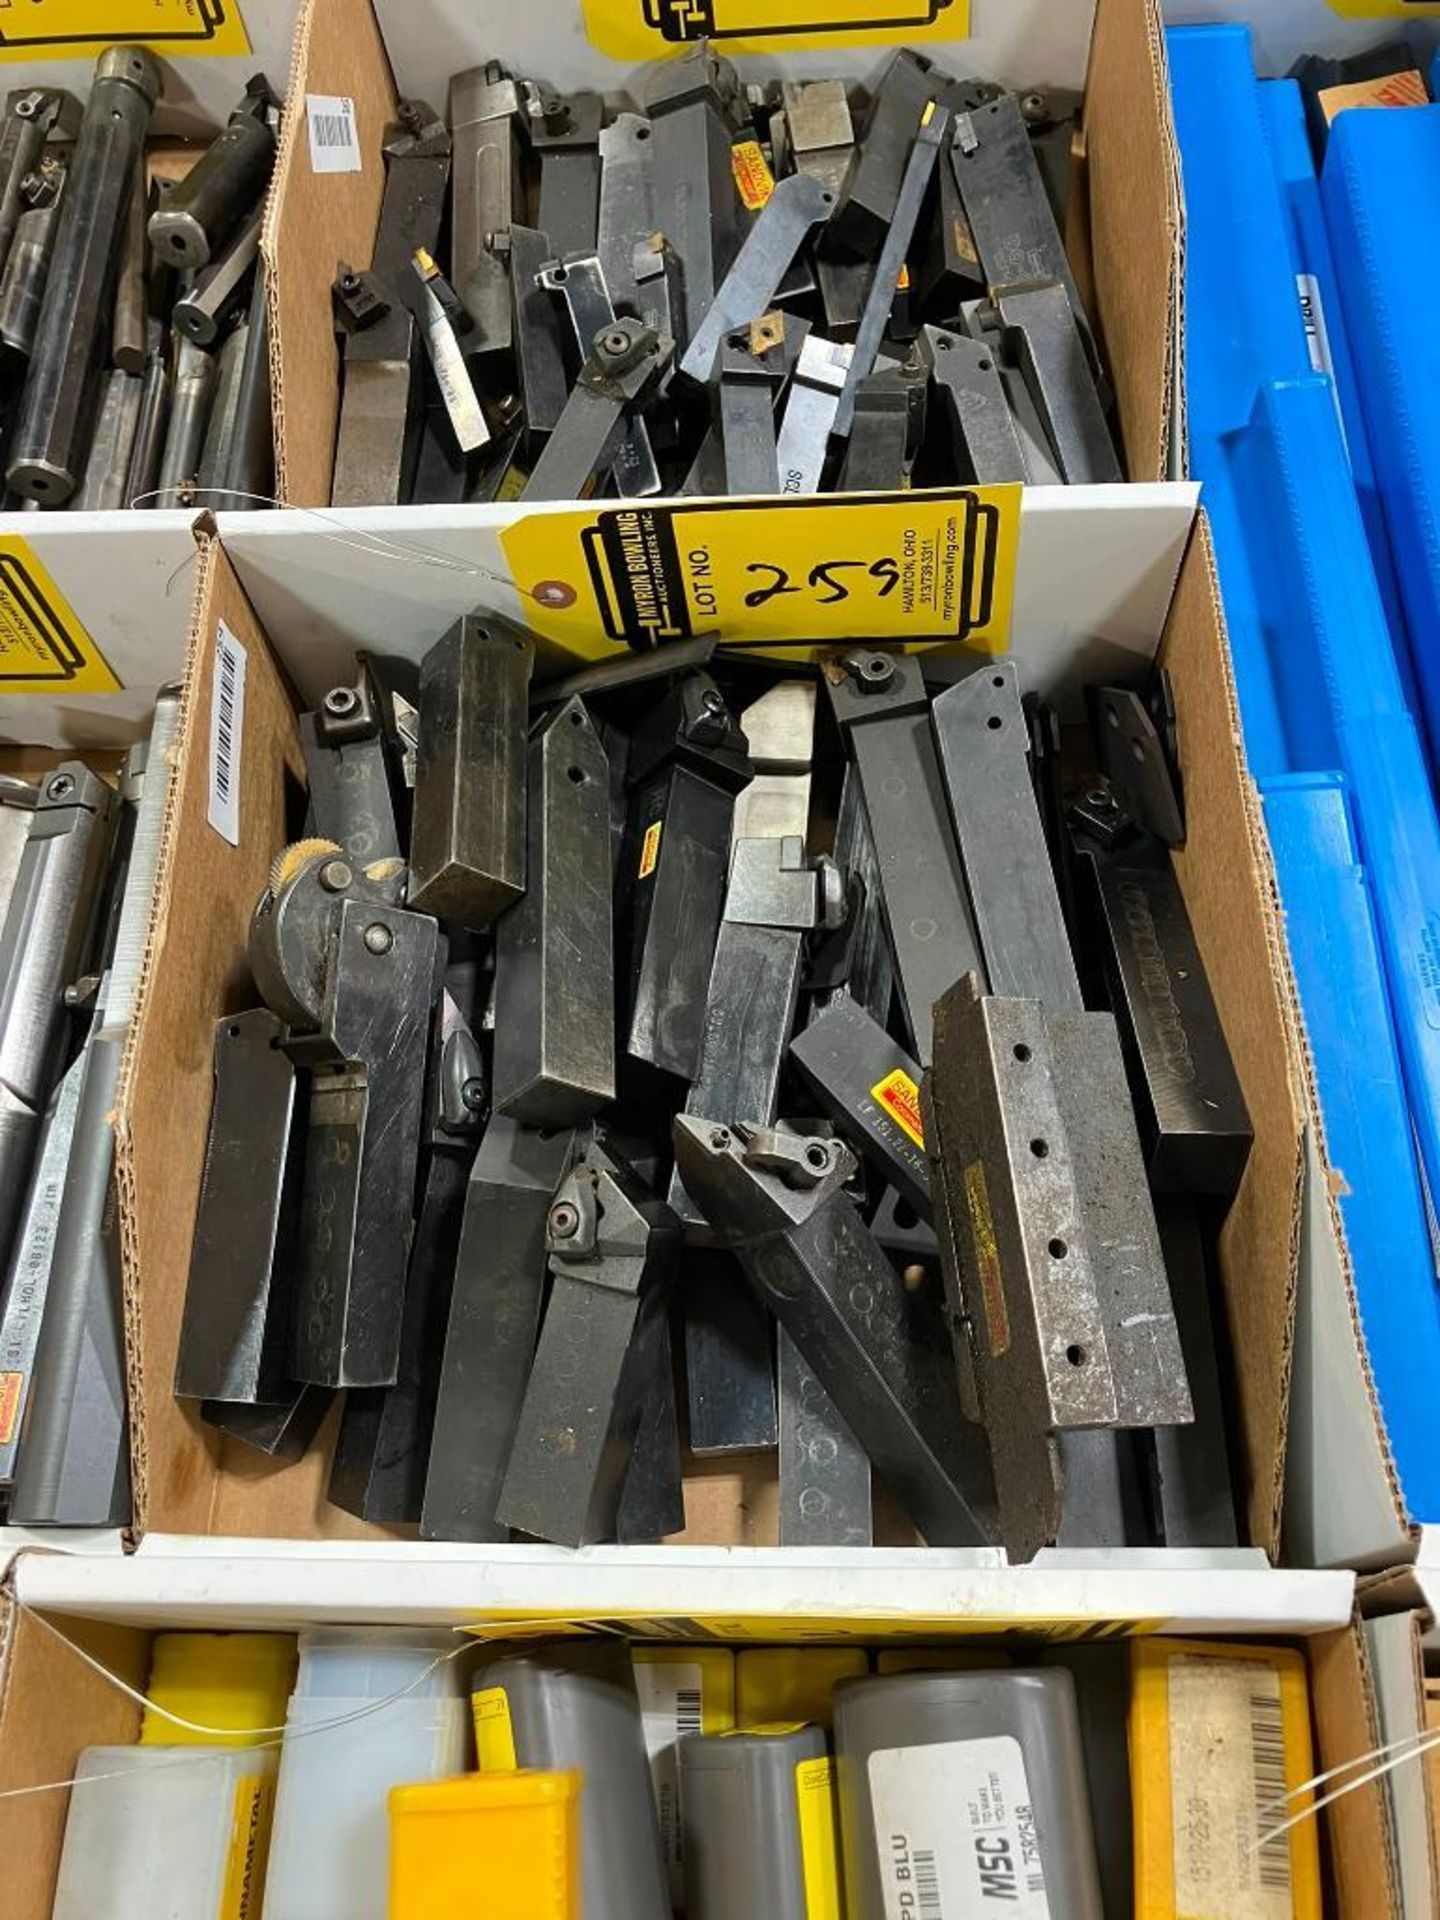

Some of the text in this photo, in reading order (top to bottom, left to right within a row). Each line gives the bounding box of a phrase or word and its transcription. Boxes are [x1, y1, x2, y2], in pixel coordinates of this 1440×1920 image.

[616, 512, 660, 618] MYRON BOWLING
[647, 535, 669, 603] AUCTIONEERS
[689, 544, 717, 616] LOT NO.
[745, 557, 900, 608] 259
[902, 529, 917, 614] HAMILTON, OHIO
[943, 516, 960, 620] myronbowling.com
[891, 1834, 911, 1880] BLU
[975, 1837, 1018, 1900] MSC
